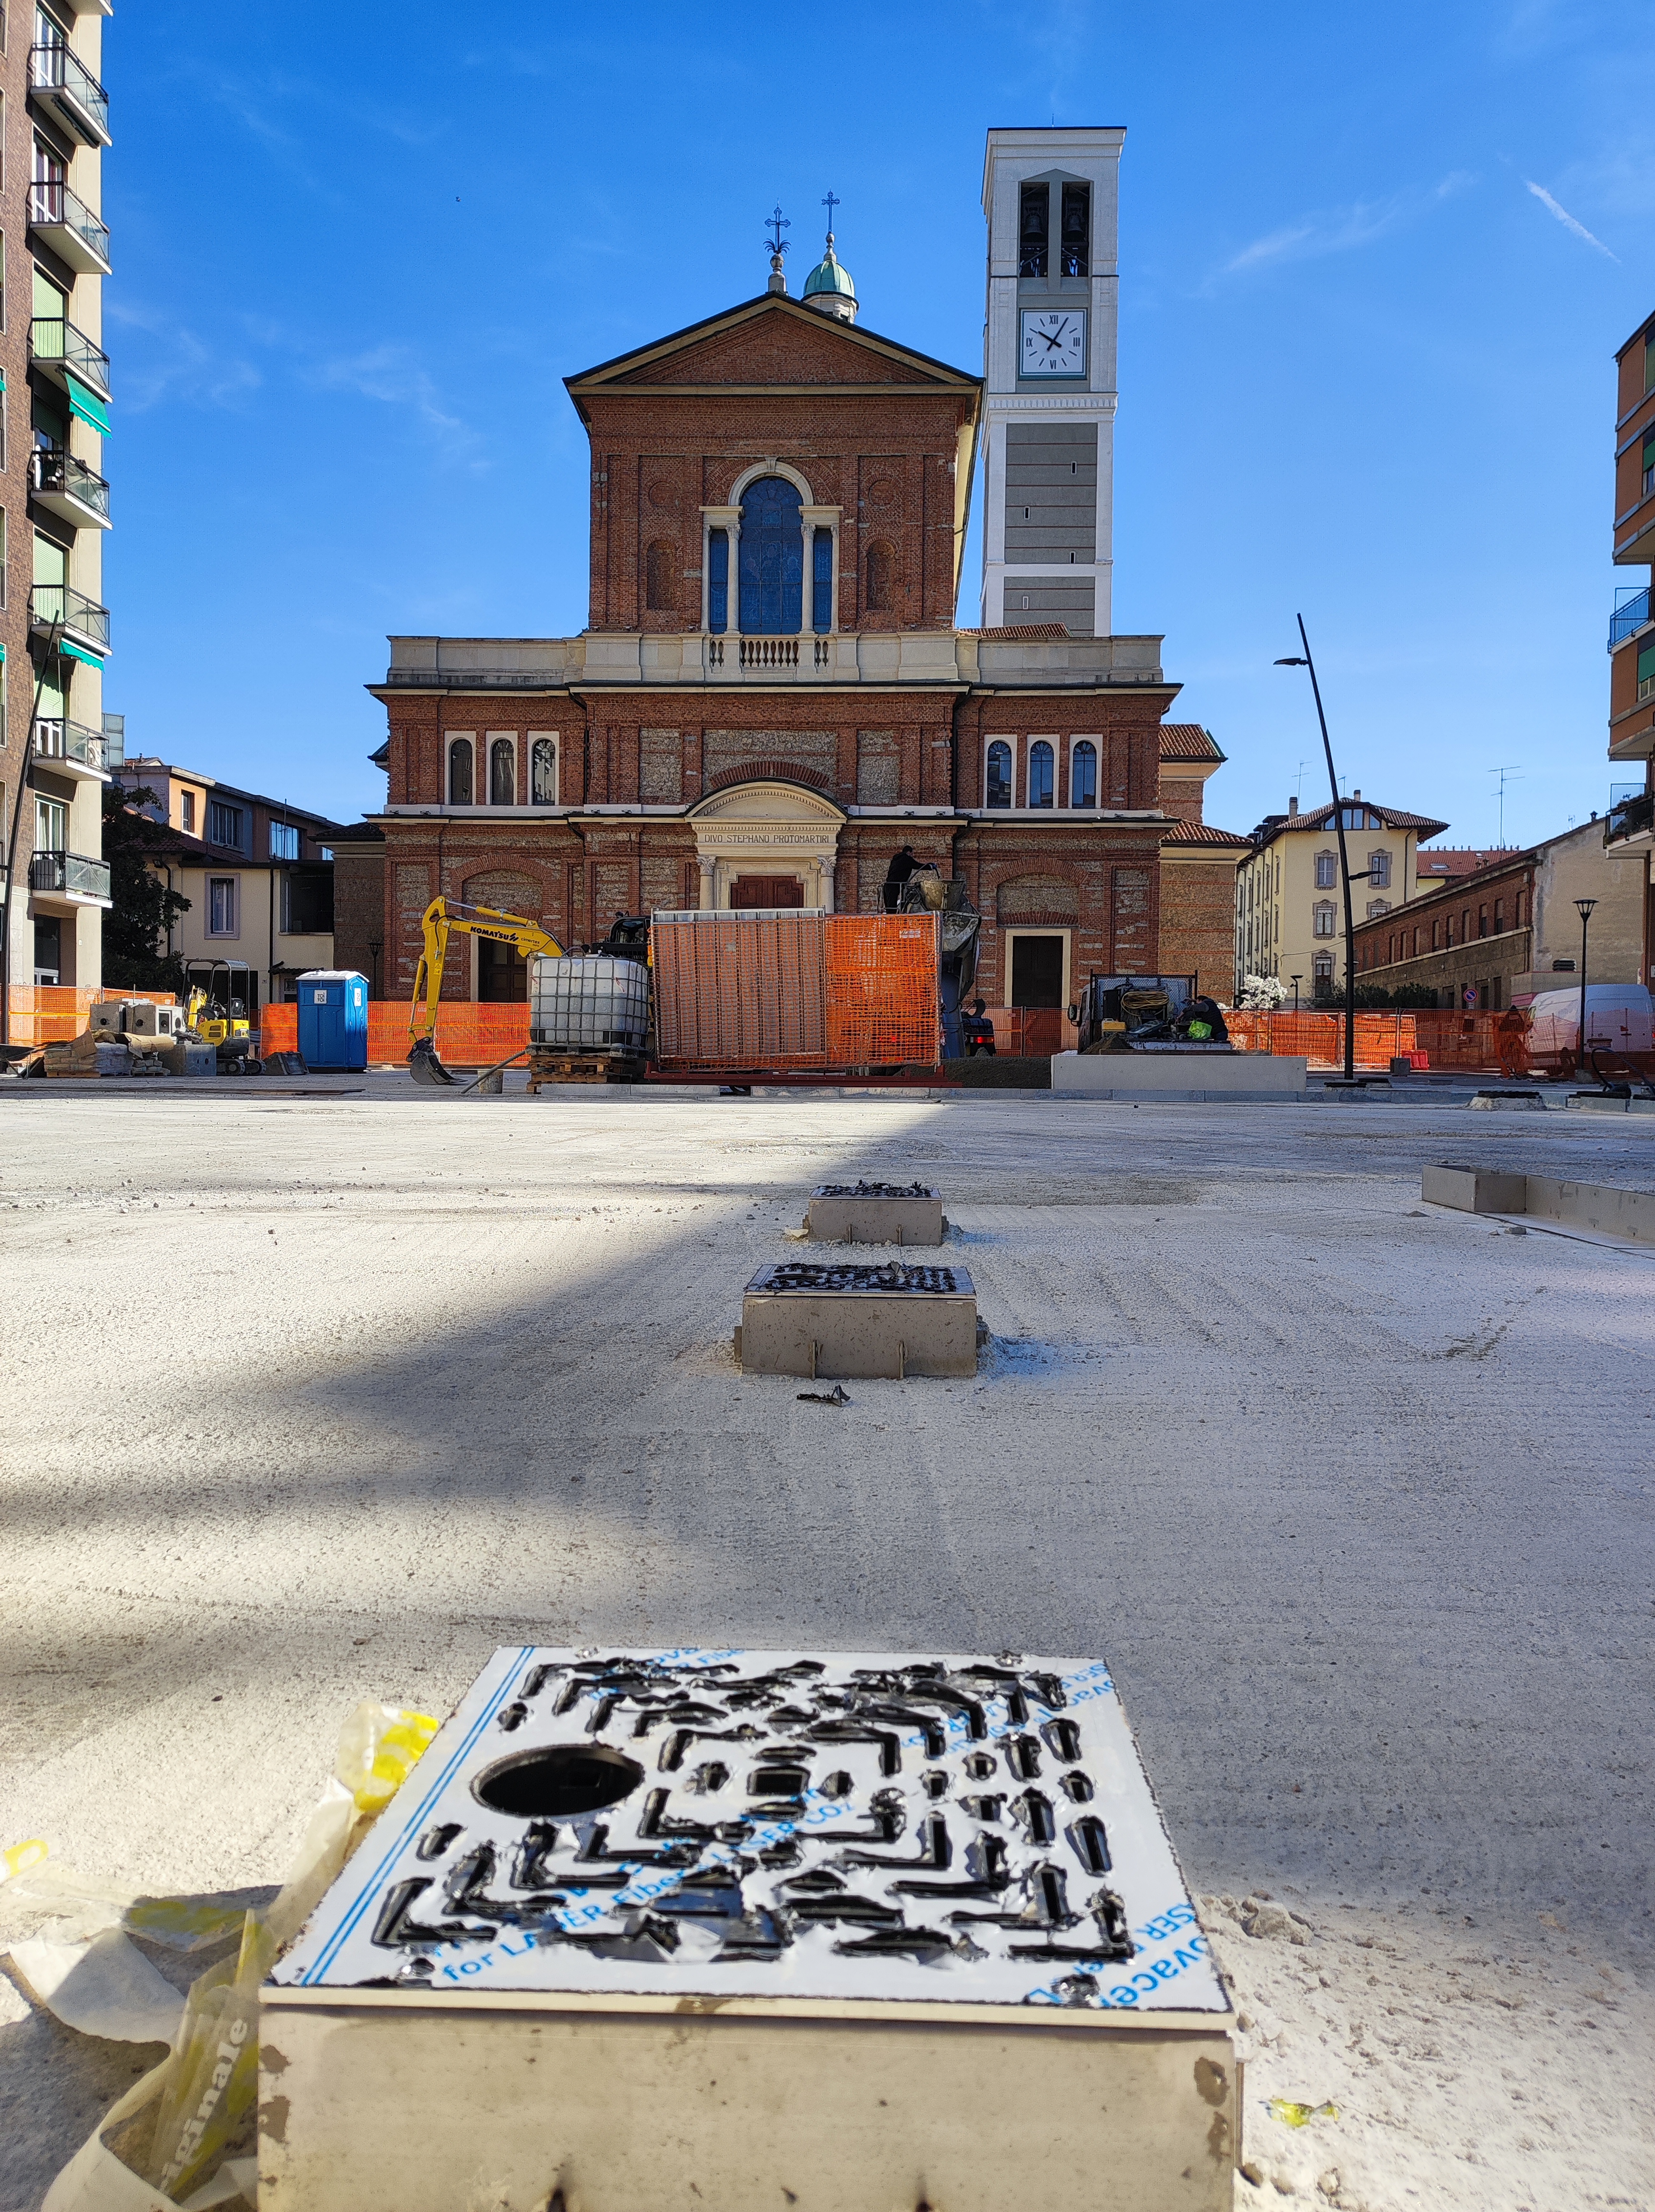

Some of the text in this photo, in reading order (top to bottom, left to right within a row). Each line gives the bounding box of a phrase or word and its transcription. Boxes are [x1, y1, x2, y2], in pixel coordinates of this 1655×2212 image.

[1049, 315, 1059, 325] XII
[1026, 337, 1033, 348] IX
[1049, 359, 1057, 370] VI
[705, 834, 829, 843] DIVO STEPHANO PROTOMARTIRI
[470, 926, 510, 940] KOMATSU
[442, 1951, 493, 1982] for
[500, 1903, 603, 1957] LAER
